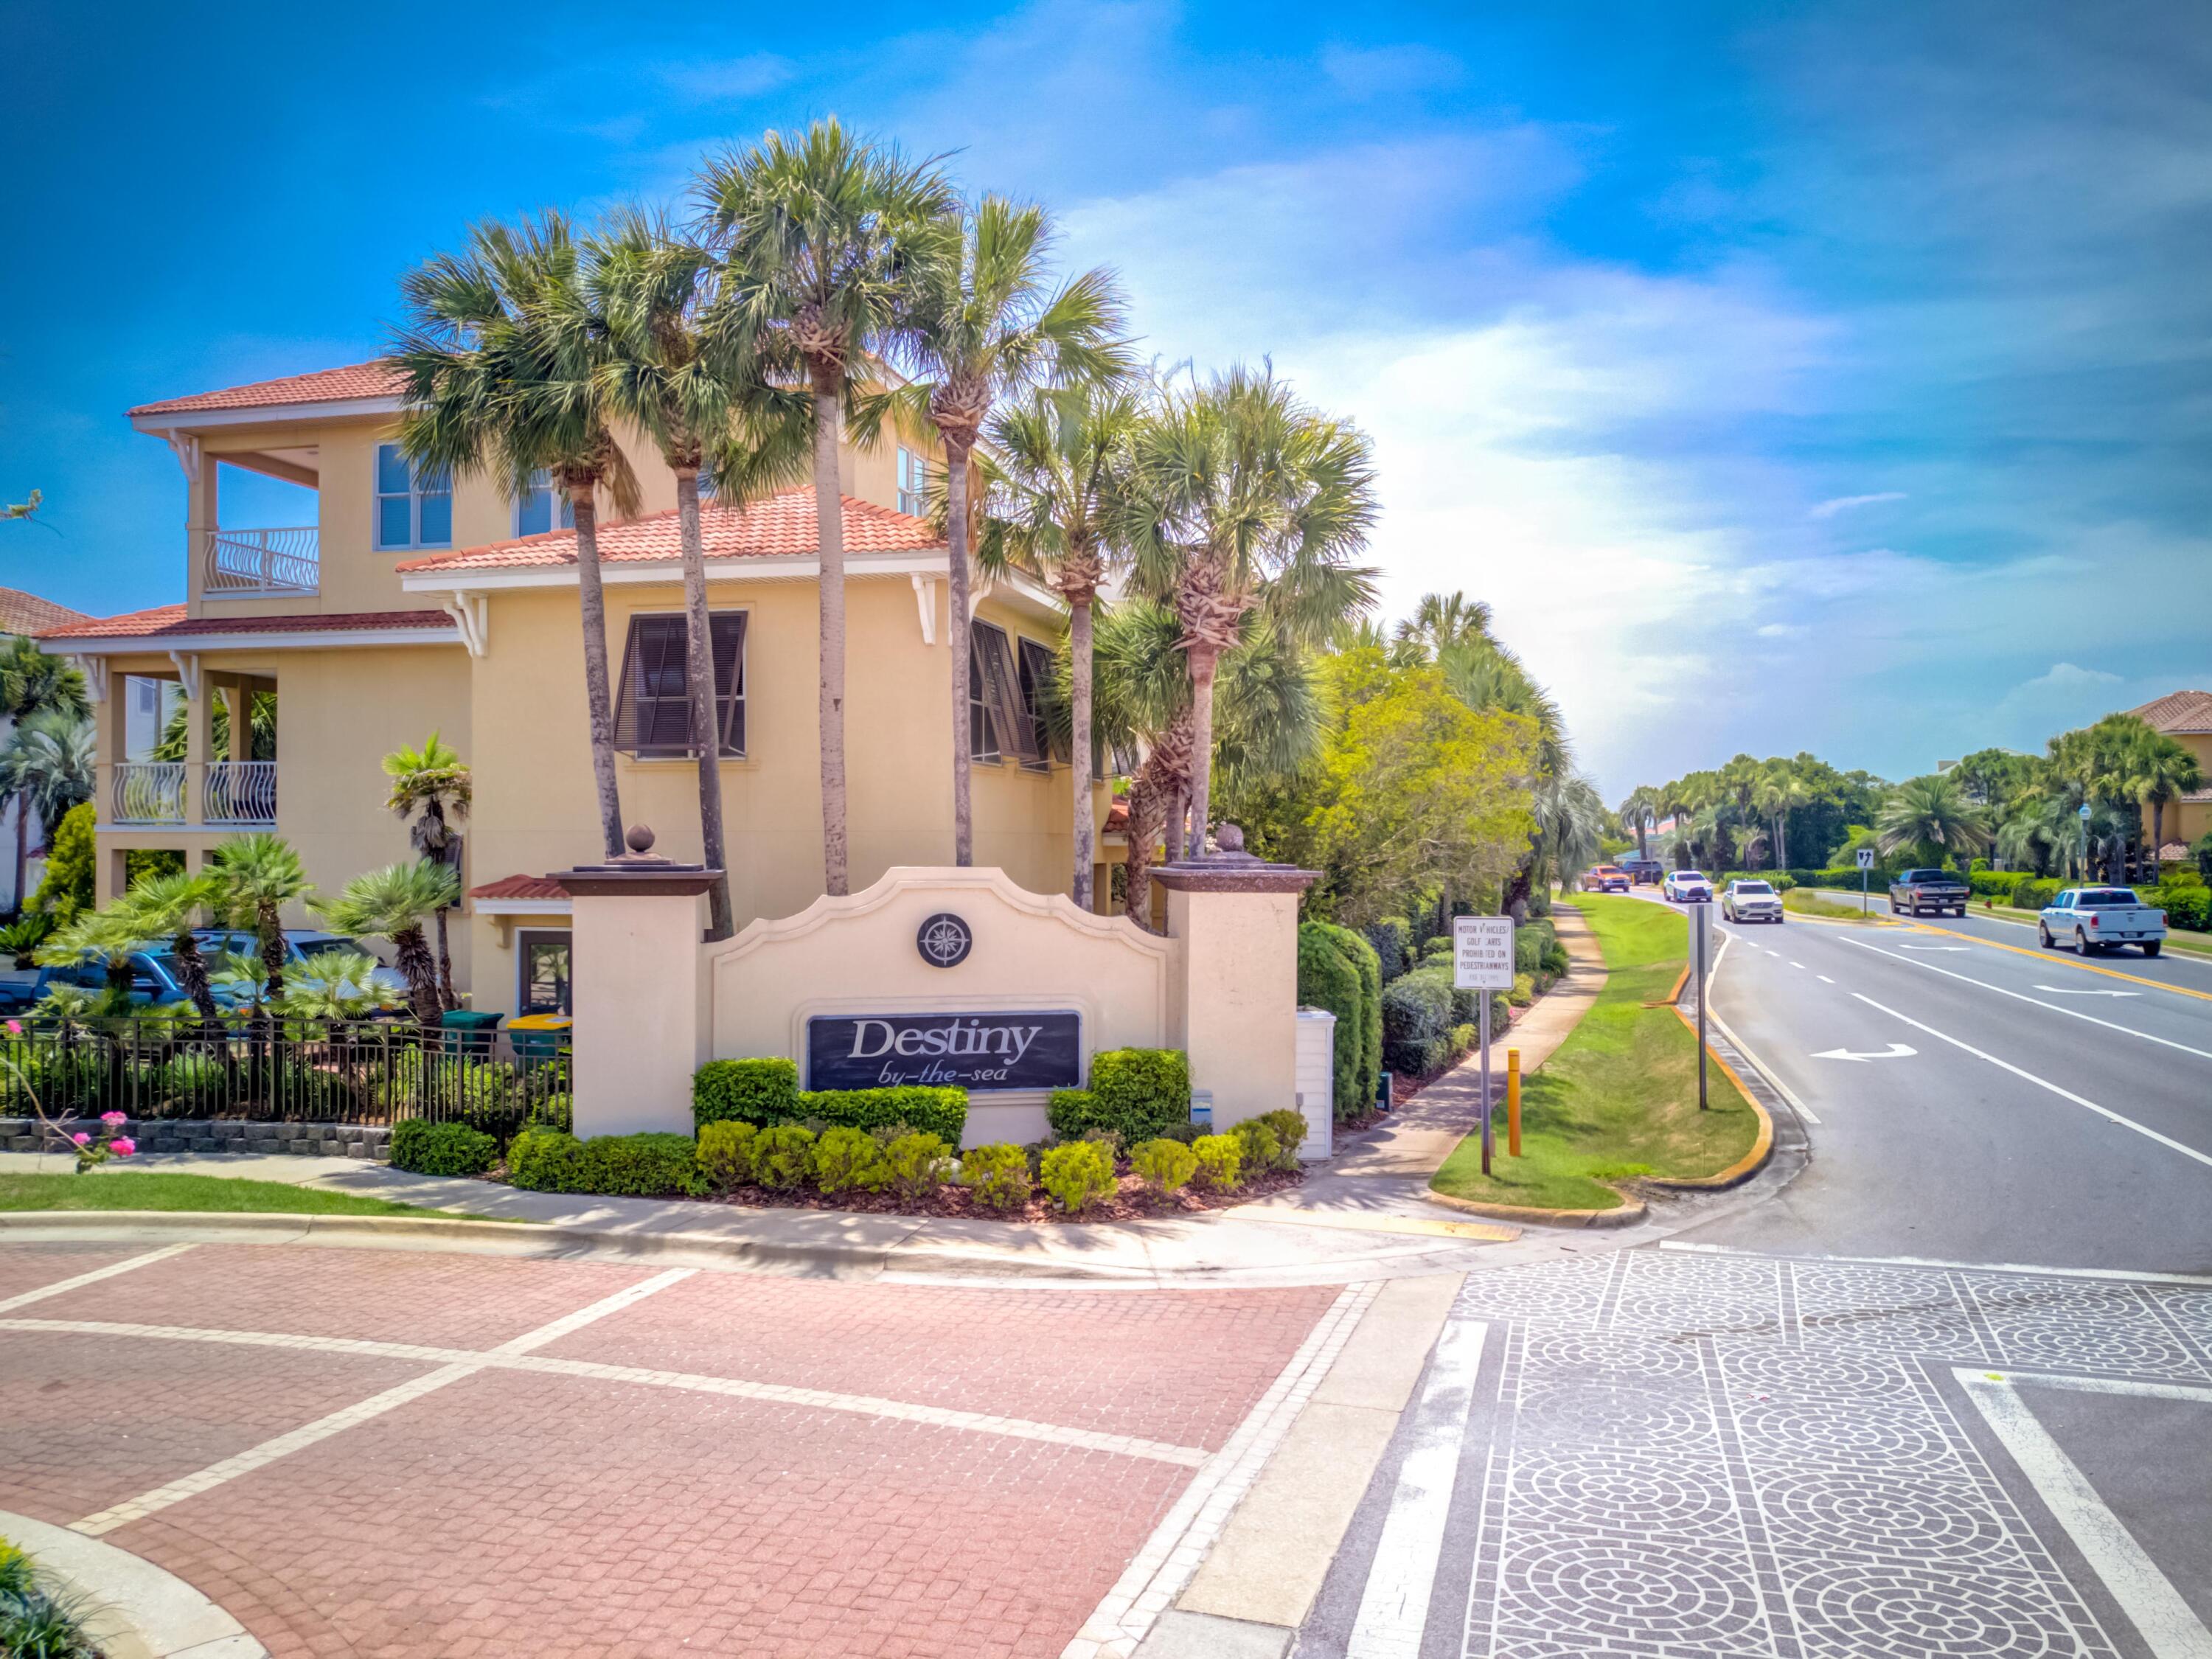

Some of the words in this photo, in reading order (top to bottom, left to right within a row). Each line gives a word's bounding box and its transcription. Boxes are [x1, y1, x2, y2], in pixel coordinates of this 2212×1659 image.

[1458, 925, 1477, 933] MOTOR
[1479, 925, 1510, 934] VHICLES/
[1467, 937, 1481, 946] GOLF
[1462, 949, 1495, 958] PROHIBTED
[1498, 950, 1506, 959] ON
[1460, 961, 1509, 970] PEDESTRIANWAYS
[846, 1018, 1043, 1065] Destiny
[877, 1059, 1009, 1088] by-the-sea
